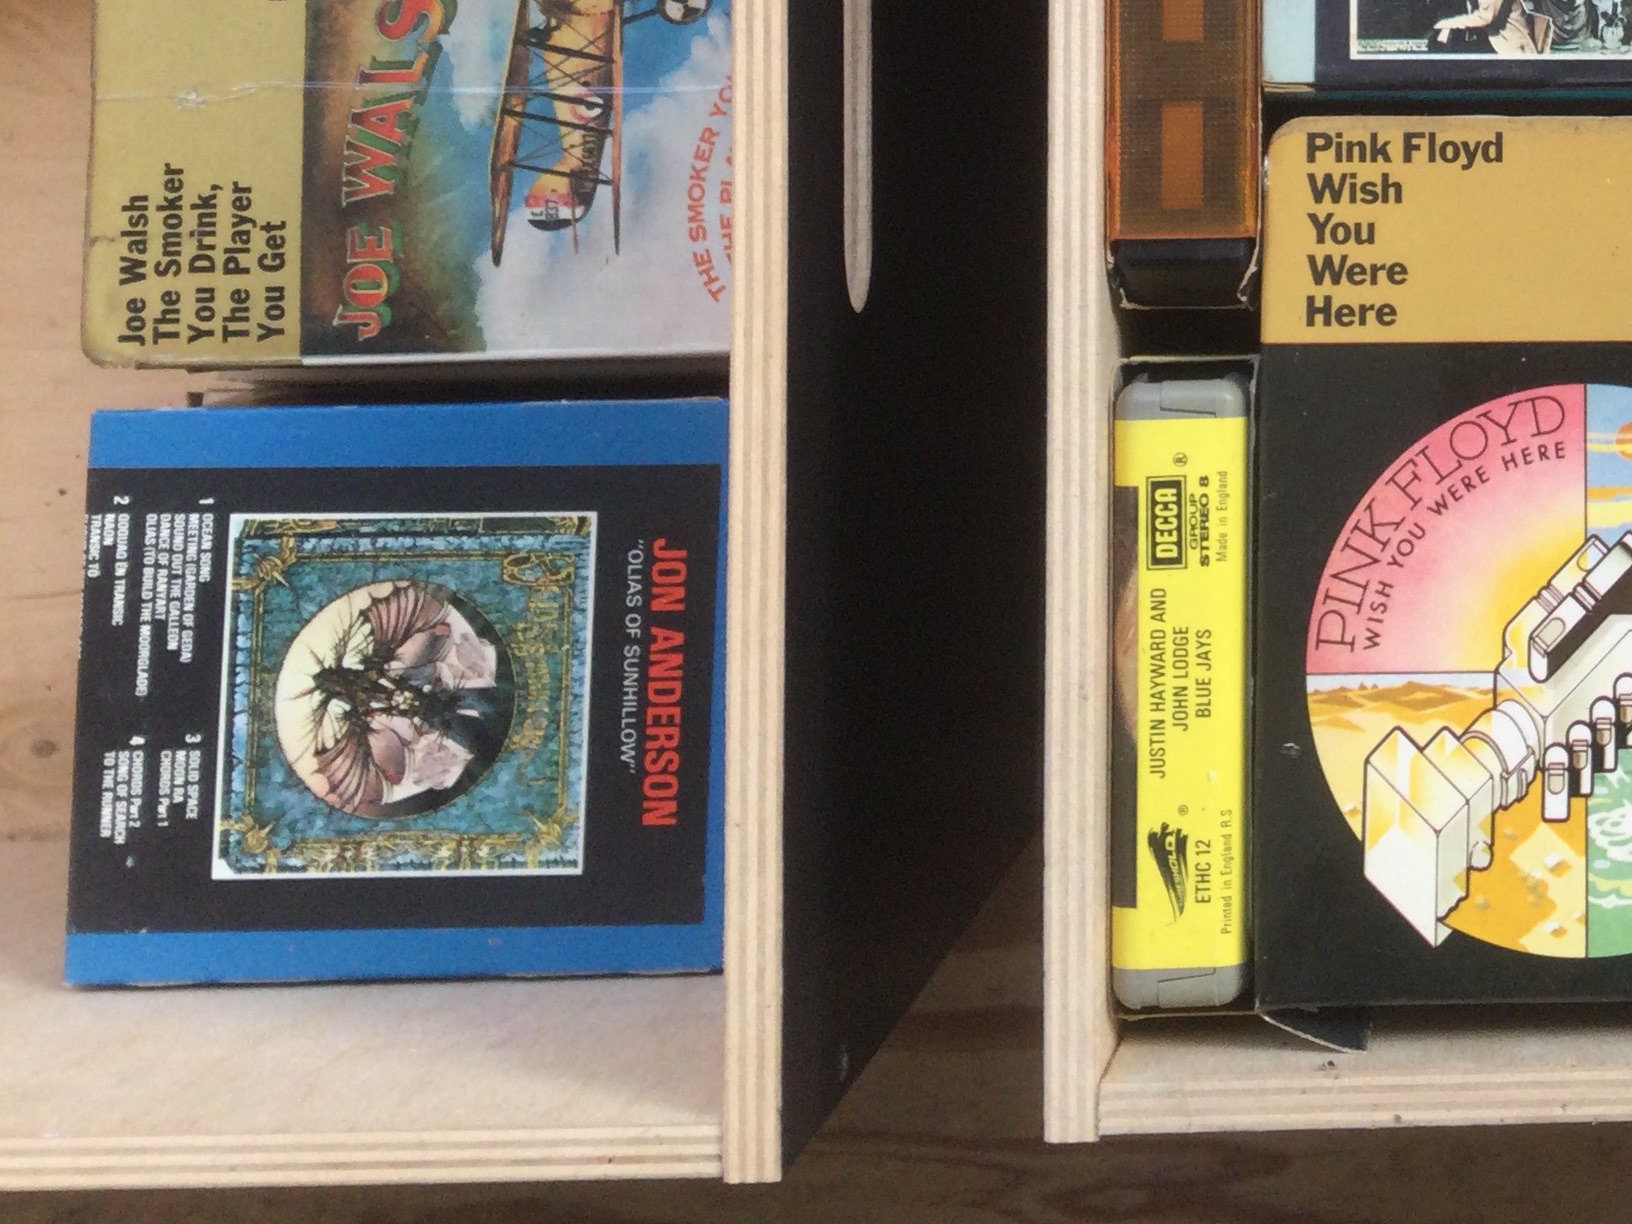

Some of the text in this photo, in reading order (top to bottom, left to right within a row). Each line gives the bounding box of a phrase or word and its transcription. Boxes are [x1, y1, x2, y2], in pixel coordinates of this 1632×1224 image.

[687, 126, 721, 243] SMOKER
[1306, 131, 1505, 171] Pink Floyd
[1306, 172, 1403, 205] Wish
[116, 194, 149, 347] Joe Walsh
[152, 162, 184, 346] The Smoker
[186, 183, 224, 344] You Drink,
[222, 180, 258, 344] The Player
[256, 220, 287, 343] You Get
[331, 224, 395, 341] JOE
[693, 248, 726, 304] THE
[1306, 212, 1376, 245] You
[1306, 253, 1409, 286] Were
[1305, 294, 1398, 327] Here
[1154, 487, 1178, 559] DECCA
[1215, 470, 1231, 562] Made in England
[1315, 393, 1566, 653] PINK FLOYD
[1362, 440, 1567, 652] WISH YOU WERE HERE
[166, 512, 186, 651] SOUND OUT THE GALLEON
[641, 537, 688, 827] JON ANDERSON
[1149, 587, 1167, 780] JUSTIN HAYWARD AND
[1172, 626, 1189, 732] JOHN LODGE
[113, 749, 131, 845] SONG OF SEARCH
